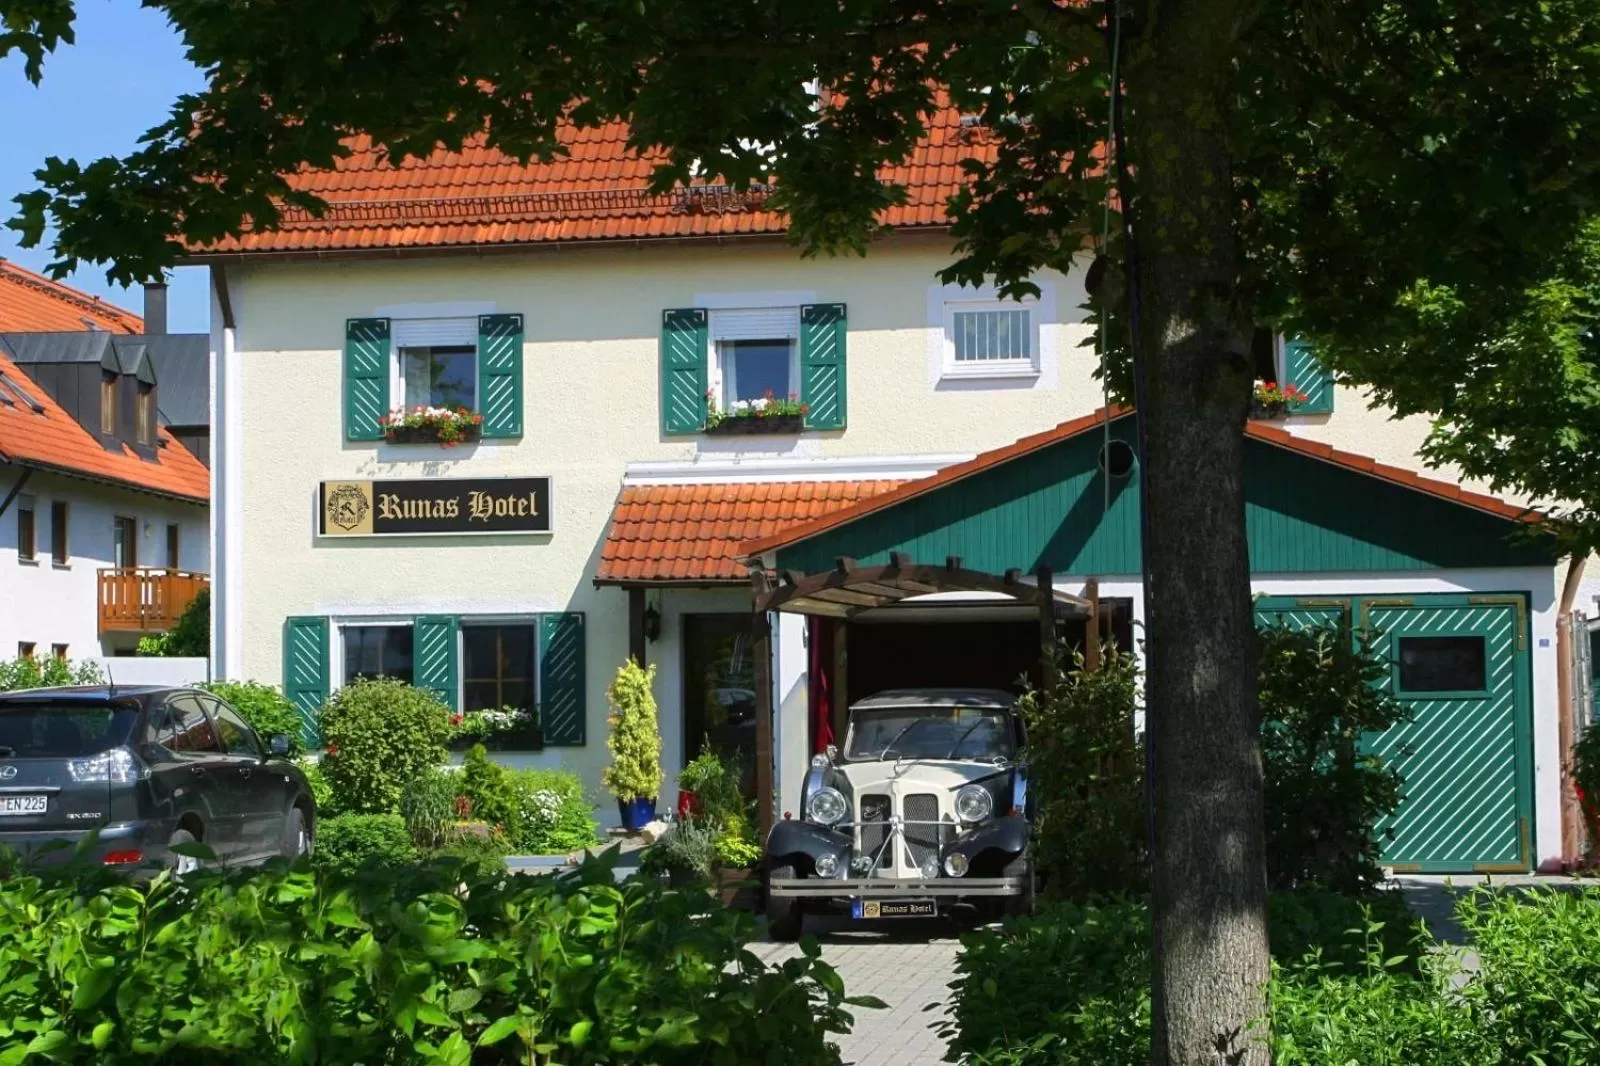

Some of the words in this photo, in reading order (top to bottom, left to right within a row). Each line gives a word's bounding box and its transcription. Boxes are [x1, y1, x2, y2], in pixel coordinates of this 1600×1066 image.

[378, 493, 459, 520] Runas
[468, 490, 539, 522] Hotel
[6, 797, 21, 811] EN
[24, 797, 46, 811] 225
